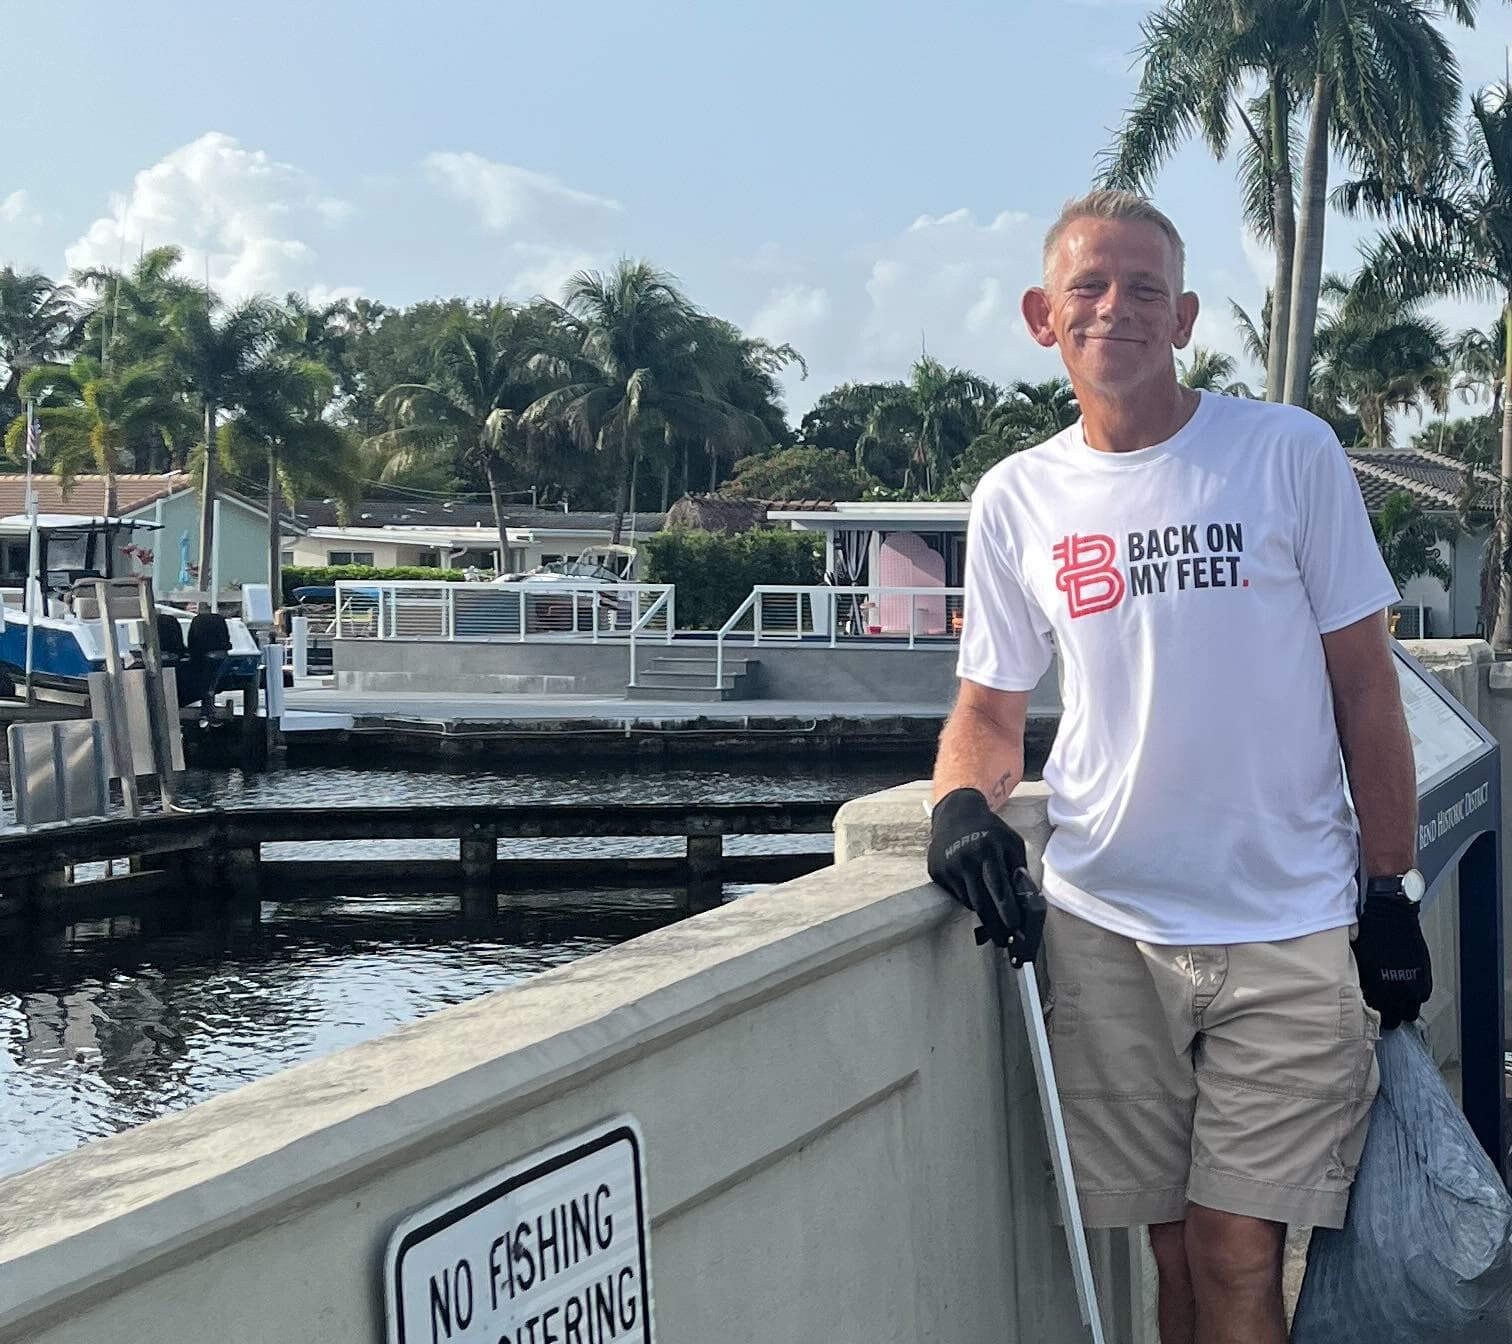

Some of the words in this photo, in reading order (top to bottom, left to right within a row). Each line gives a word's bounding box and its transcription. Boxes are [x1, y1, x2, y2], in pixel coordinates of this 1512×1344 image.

[1127, 523, 1200, 562] BACK
[1206, 522, 1244, 553] ON
[1130, 561, 1168, 597] MY
[1177, 556, 1249, 590] FEET.
[945, 831, 989, 860] HARDY
[1380, 967, 1417, 982] HARDY
[490, 1183, 615, 1311] FISHING
